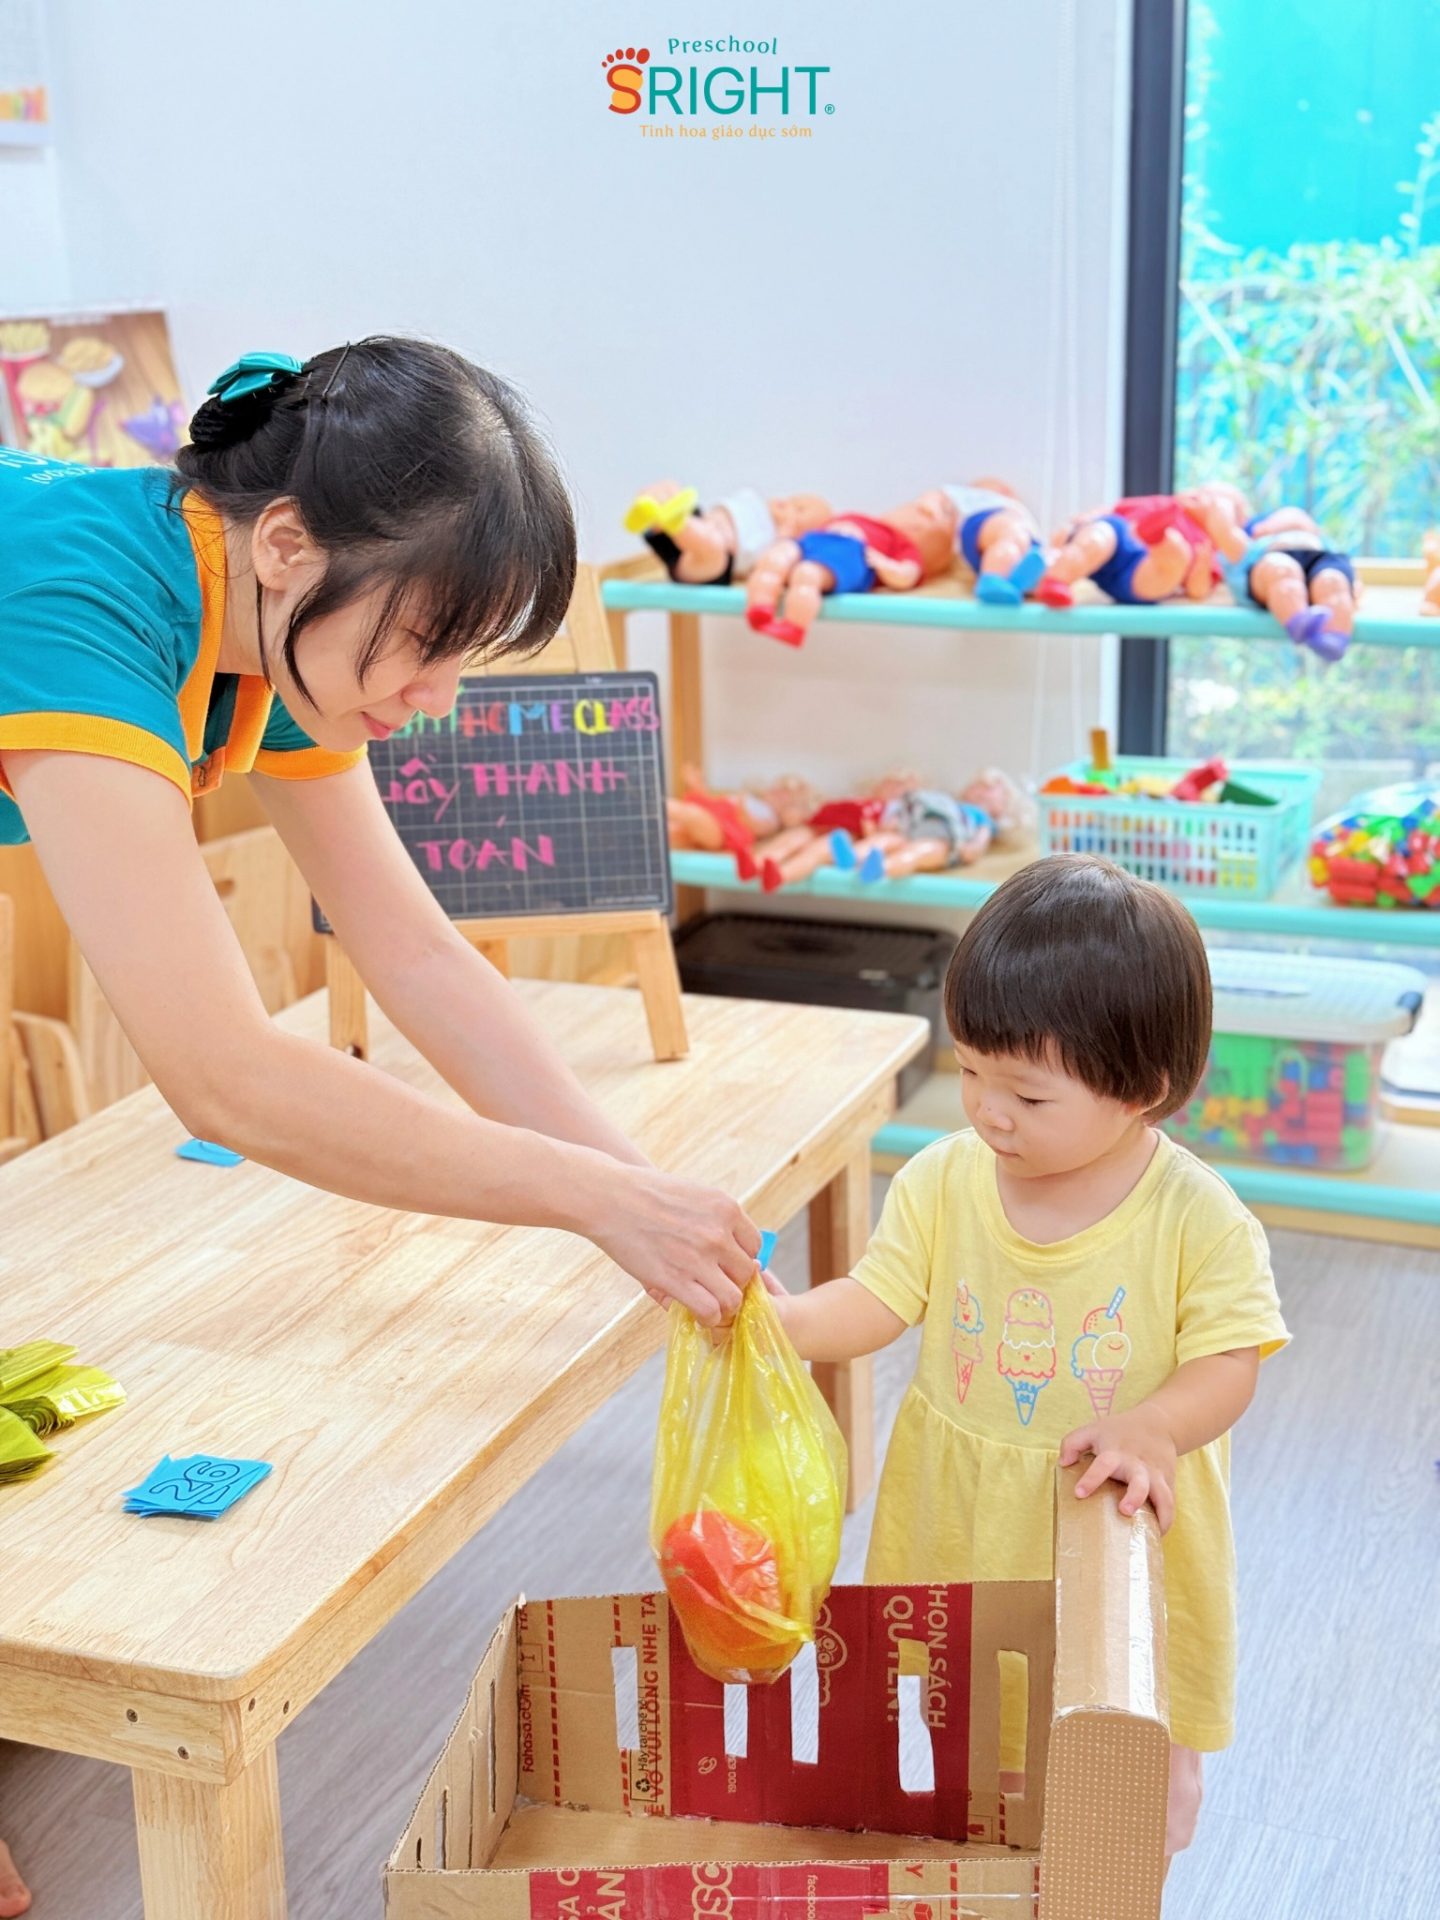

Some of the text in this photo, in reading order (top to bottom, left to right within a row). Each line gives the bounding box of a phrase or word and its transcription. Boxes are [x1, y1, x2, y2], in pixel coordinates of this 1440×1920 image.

[463, 757, 626, 798] THANH
[416, 814, 556, 872] TOÁN
[641, 1623, 661, 1665] NHẸ
[922, 1585, 953, 1729] HỌN SÁCH
[646, 1730, 663, 1764] VUI
